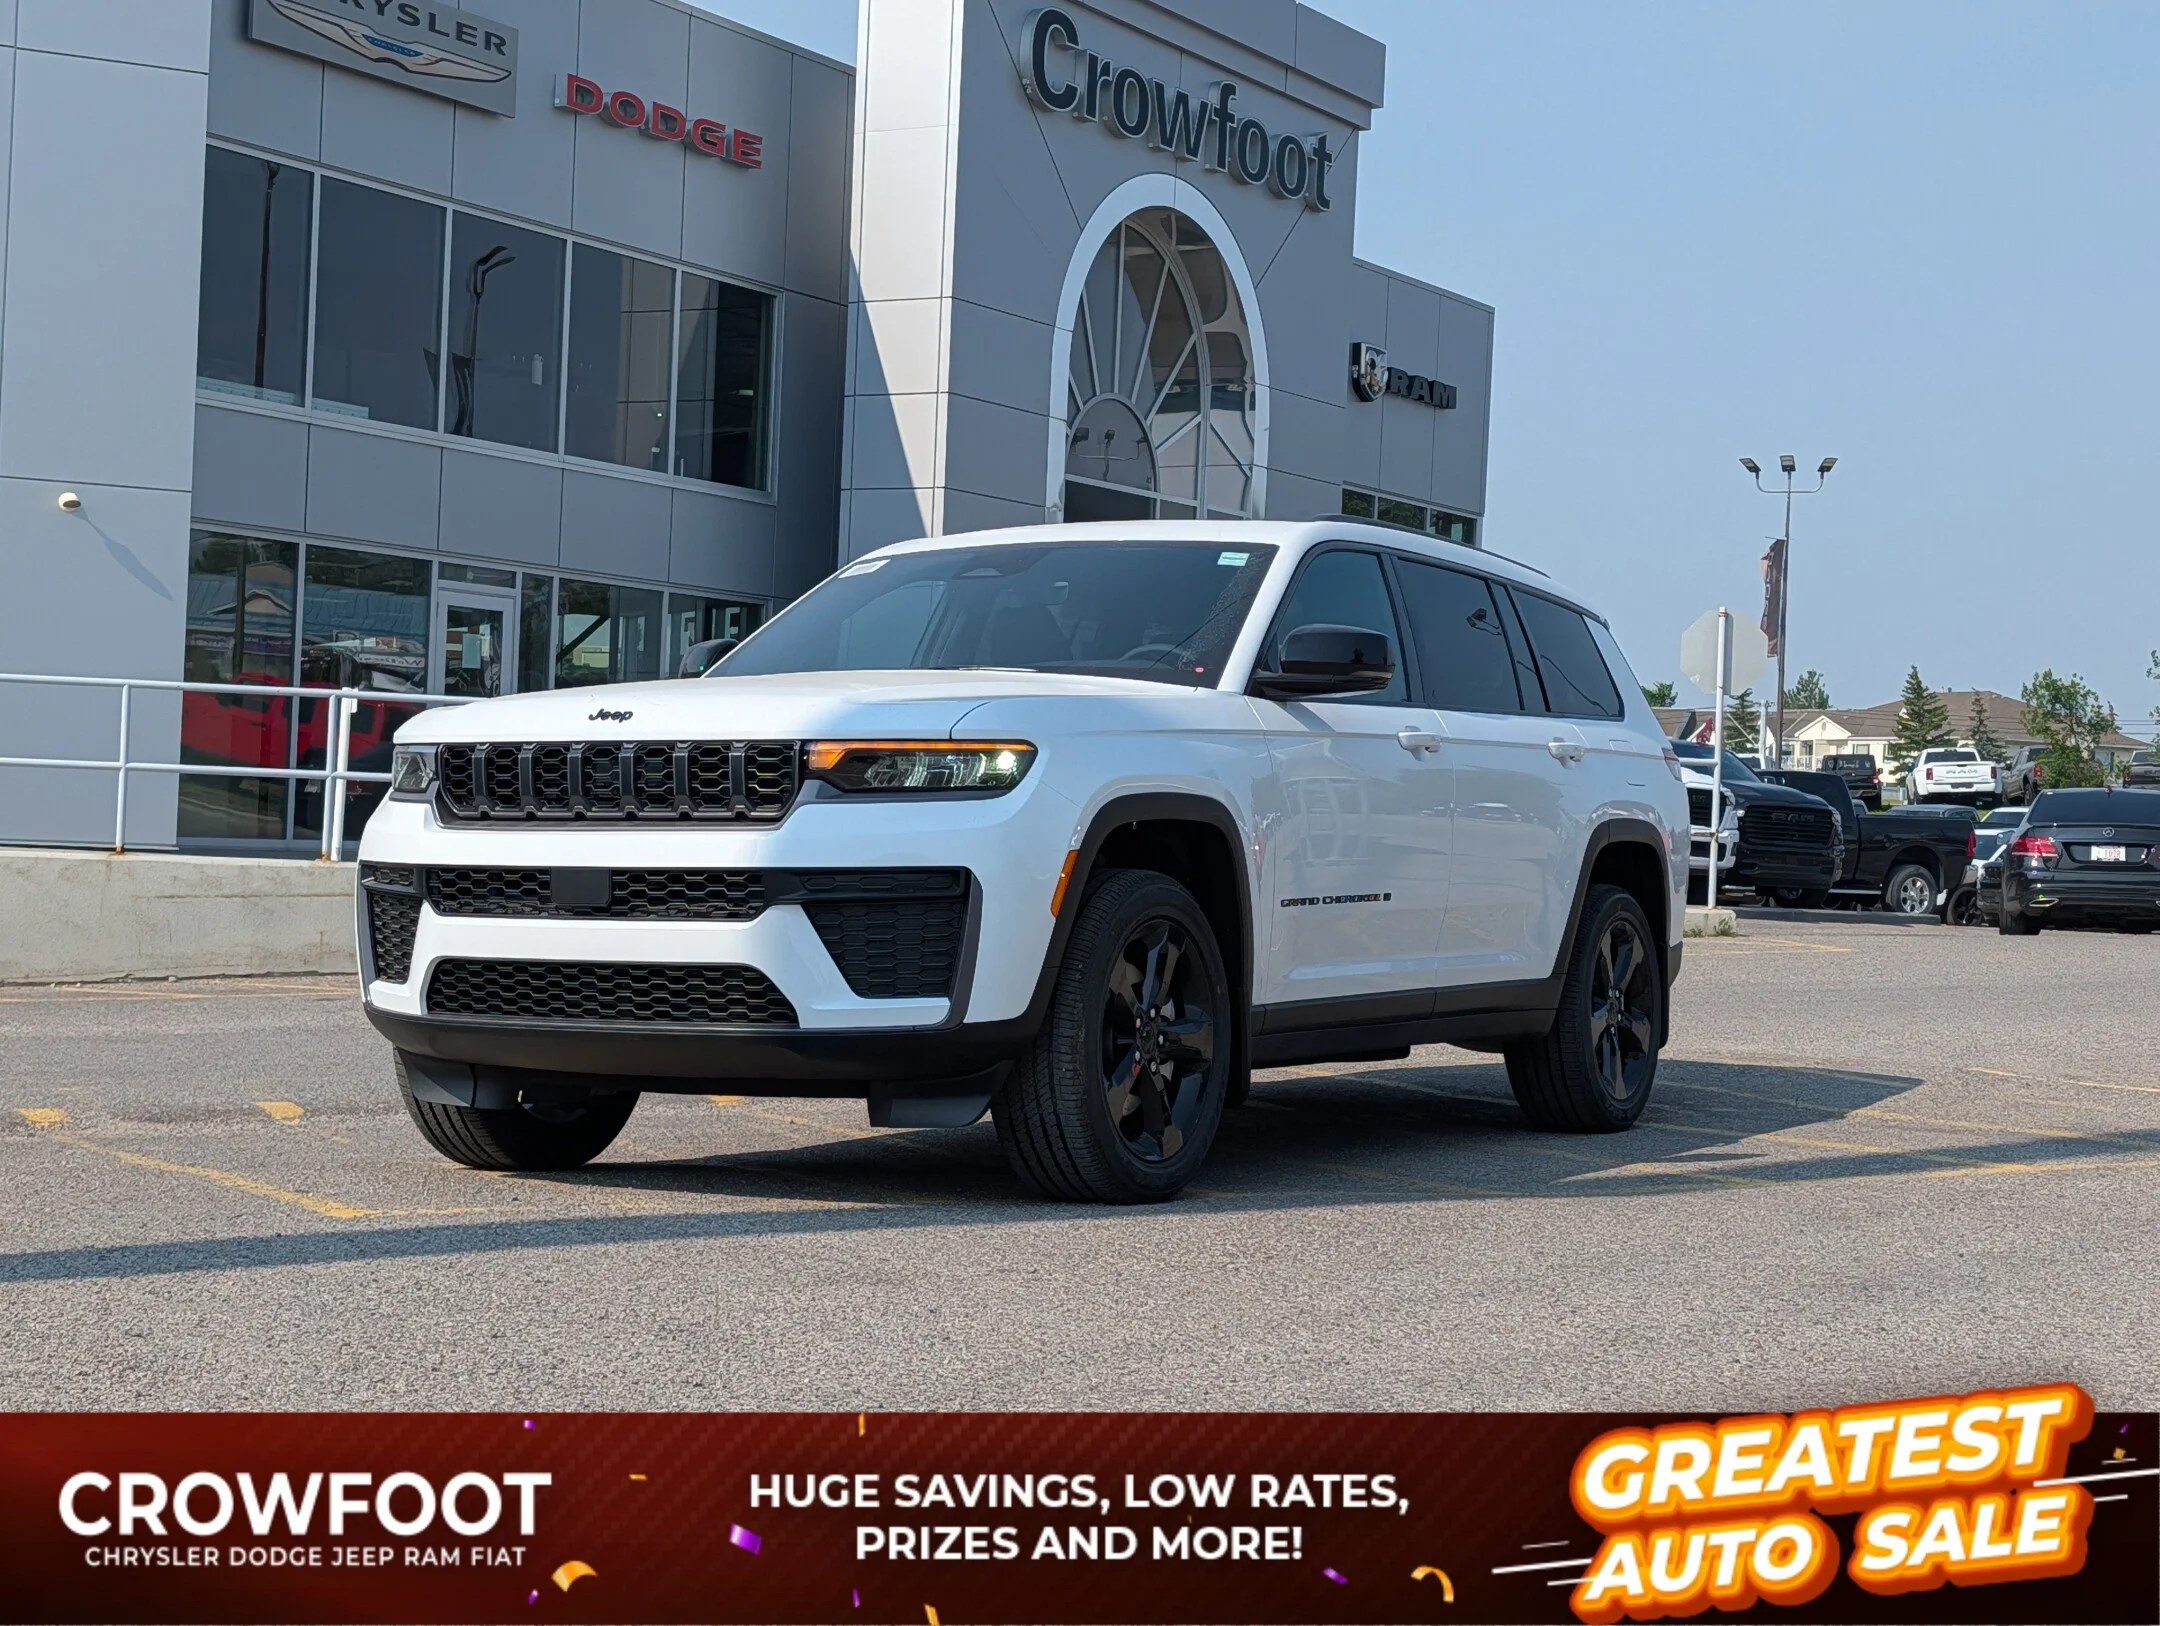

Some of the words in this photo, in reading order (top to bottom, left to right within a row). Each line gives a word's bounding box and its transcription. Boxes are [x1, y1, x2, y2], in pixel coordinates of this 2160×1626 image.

[566, 73, 763, 169] DODGE
[1031, 7, 1333, 212] Crowfoot
[1388, 367, 1457, 409] RAM
[588, 708, 634, 723] Jeep
[1280, 896, 1320, 908] GRAND
